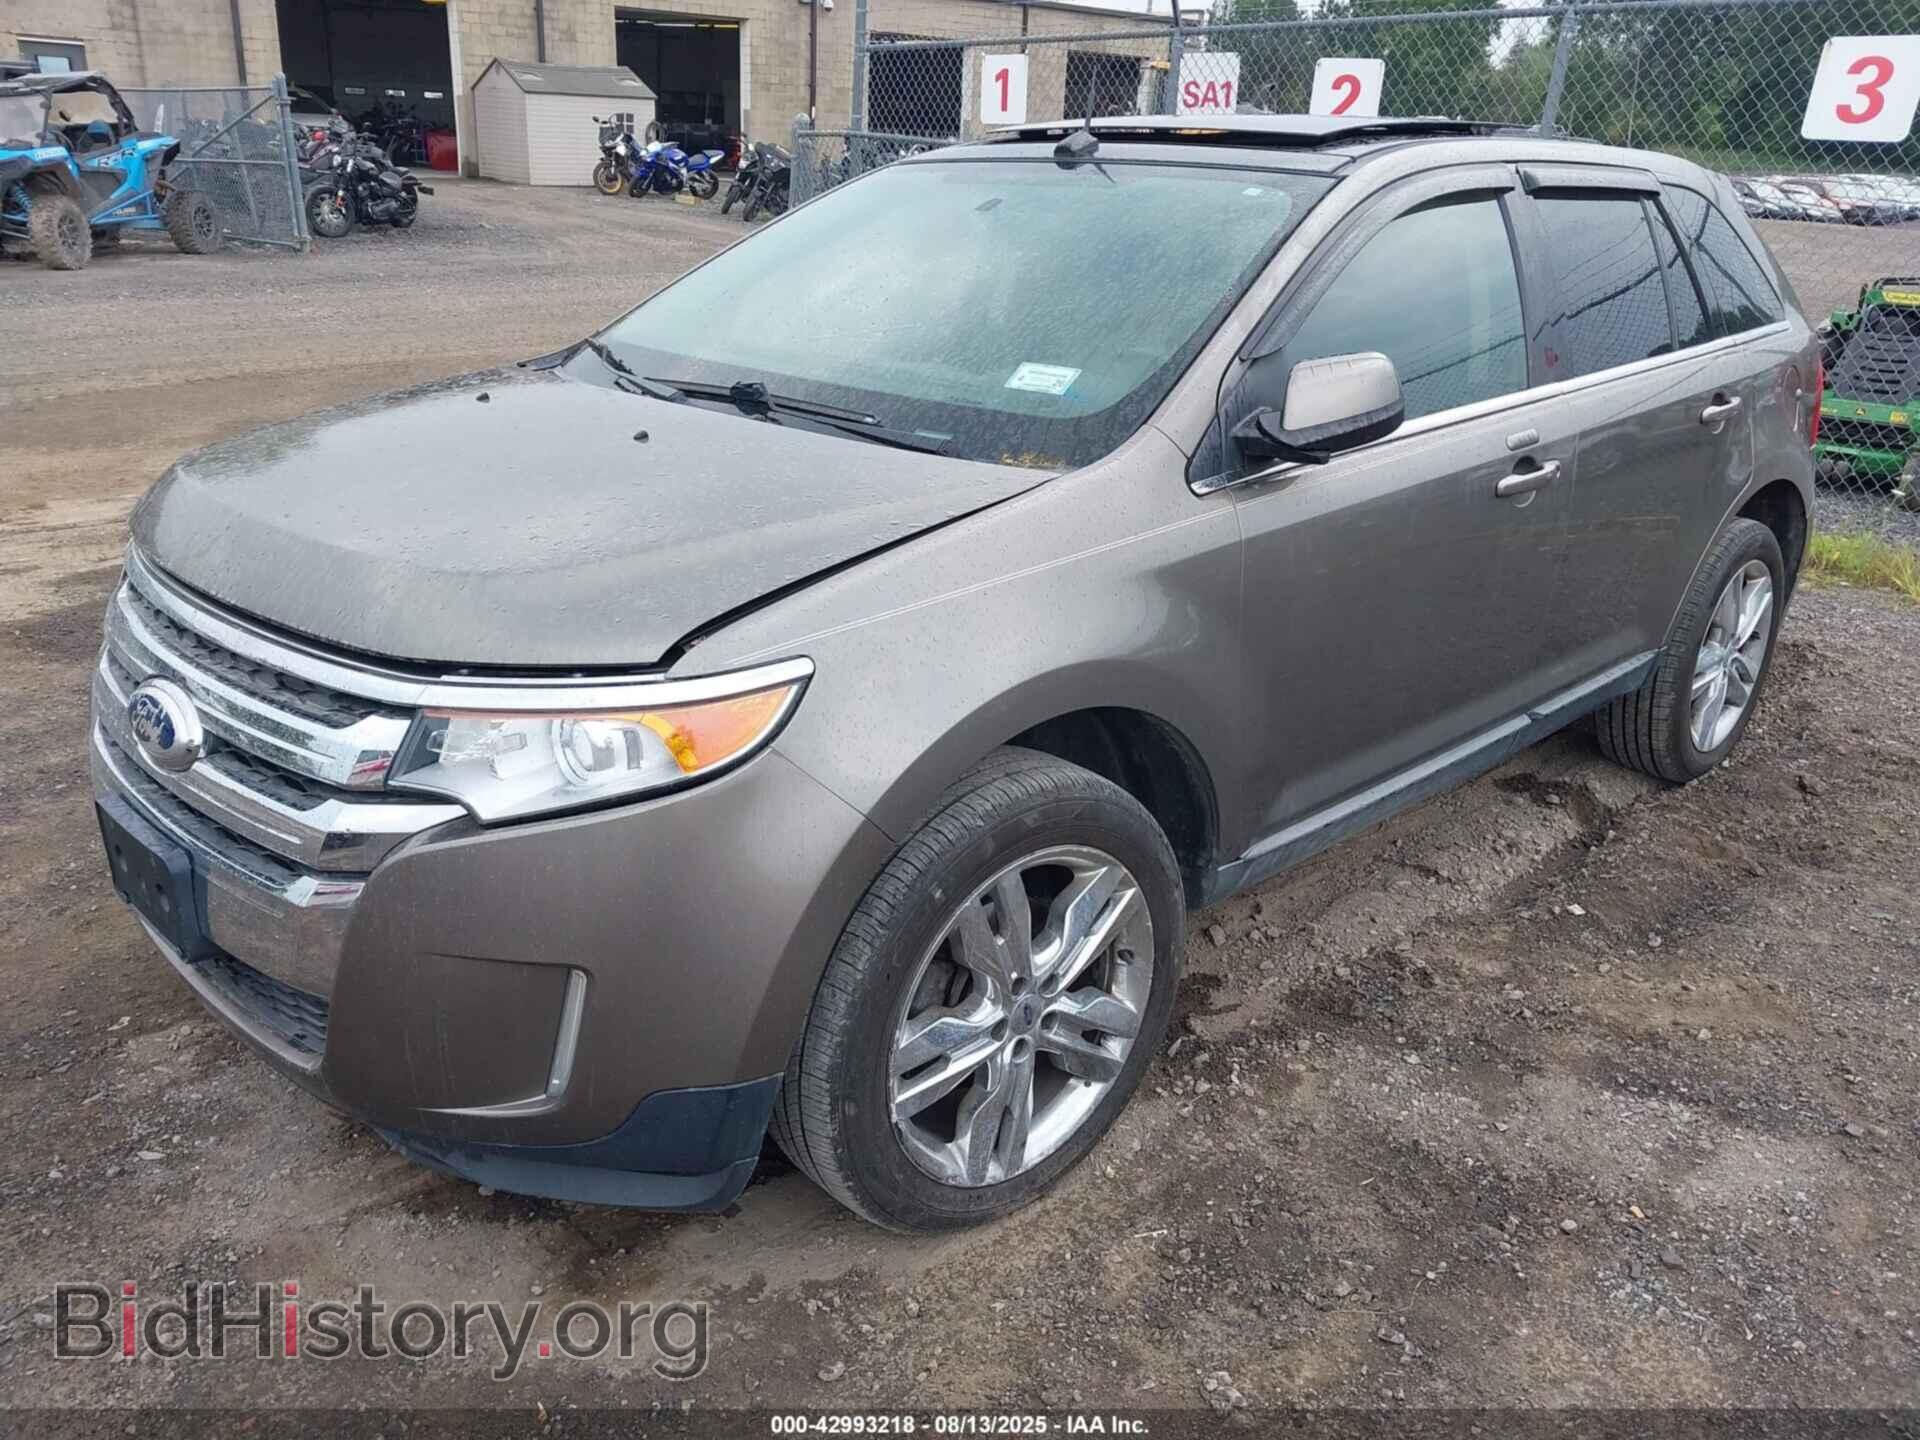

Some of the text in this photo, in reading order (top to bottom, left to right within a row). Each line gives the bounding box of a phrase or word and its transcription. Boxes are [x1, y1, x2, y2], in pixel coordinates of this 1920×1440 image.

[995, 68, 1009, 112] 1
[1183, 80, 1233, 109] SA1
[1331, 74, 1361, 115] 2
[1836, 55, 1895, 124] 3
